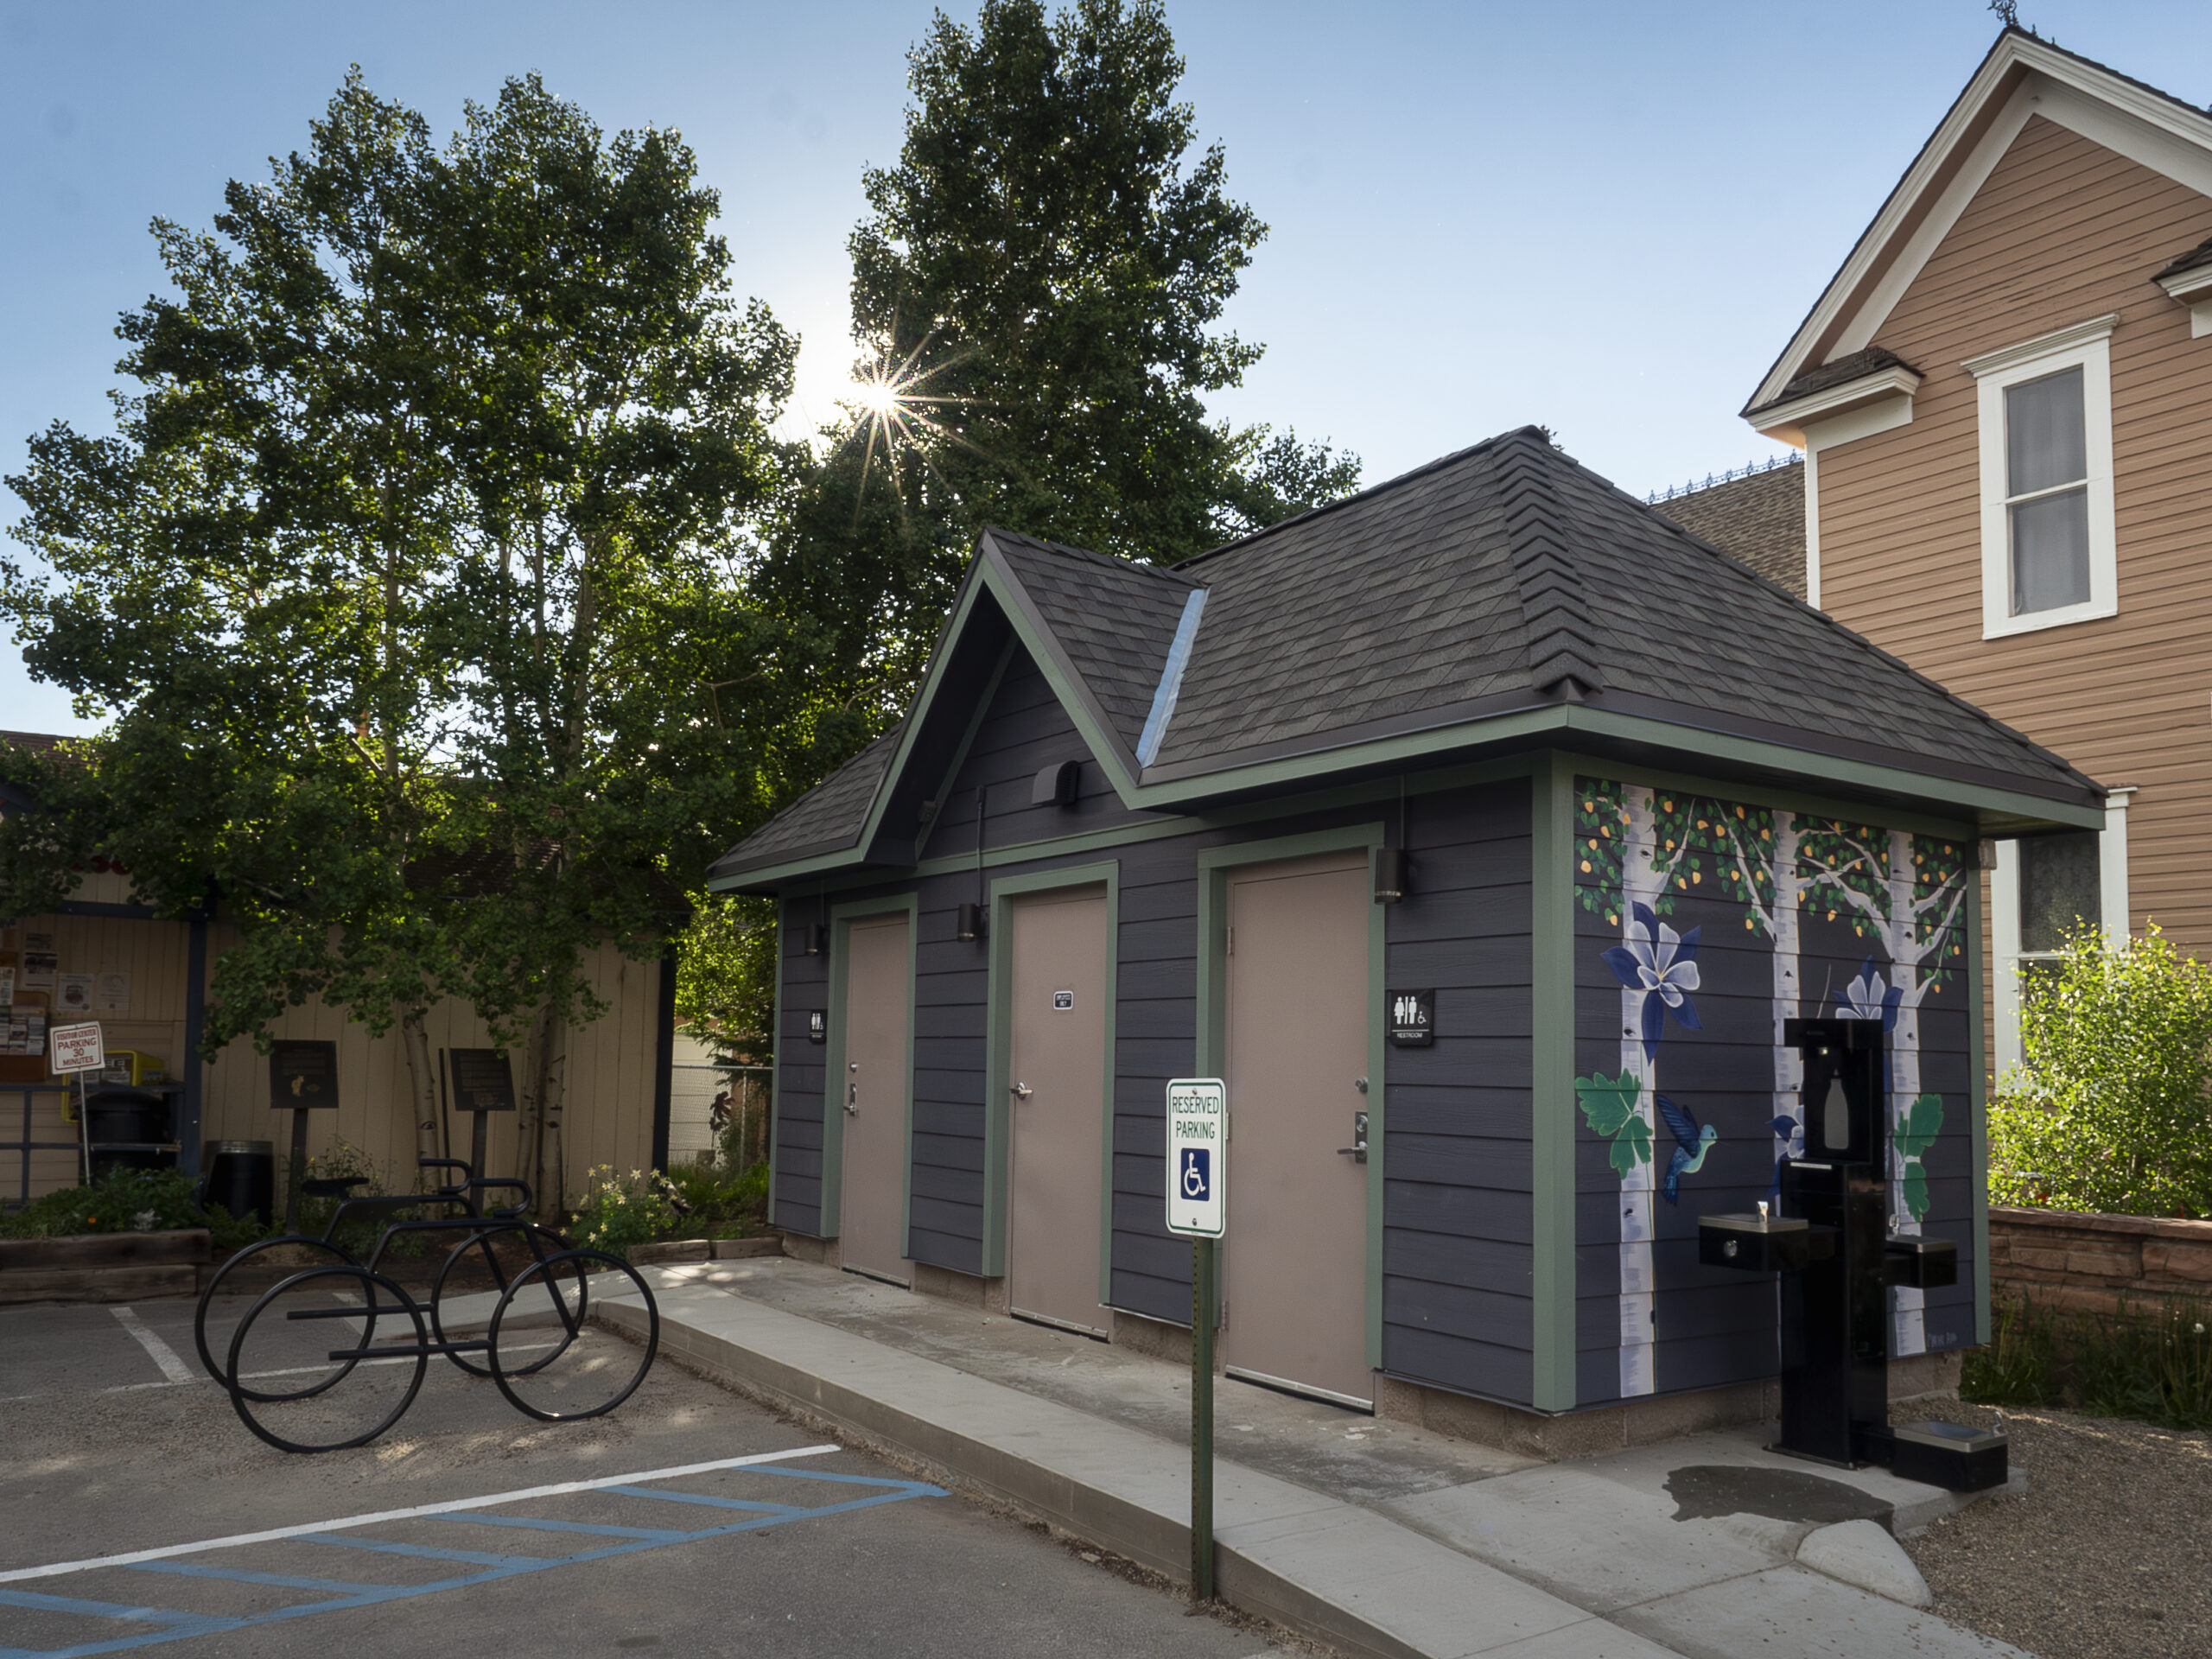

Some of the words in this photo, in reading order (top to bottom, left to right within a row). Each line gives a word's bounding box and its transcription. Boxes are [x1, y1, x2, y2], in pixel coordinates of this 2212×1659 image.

[57, 1037, 97, 1051] PARKING
[73, 1047, 85, 1058] 30
[62, 1055, 94, 1066] MINUTES
[1172, 1096, 1220, 1115] RESERVED
[1176, 1121, 1216, 1140] PARKING
